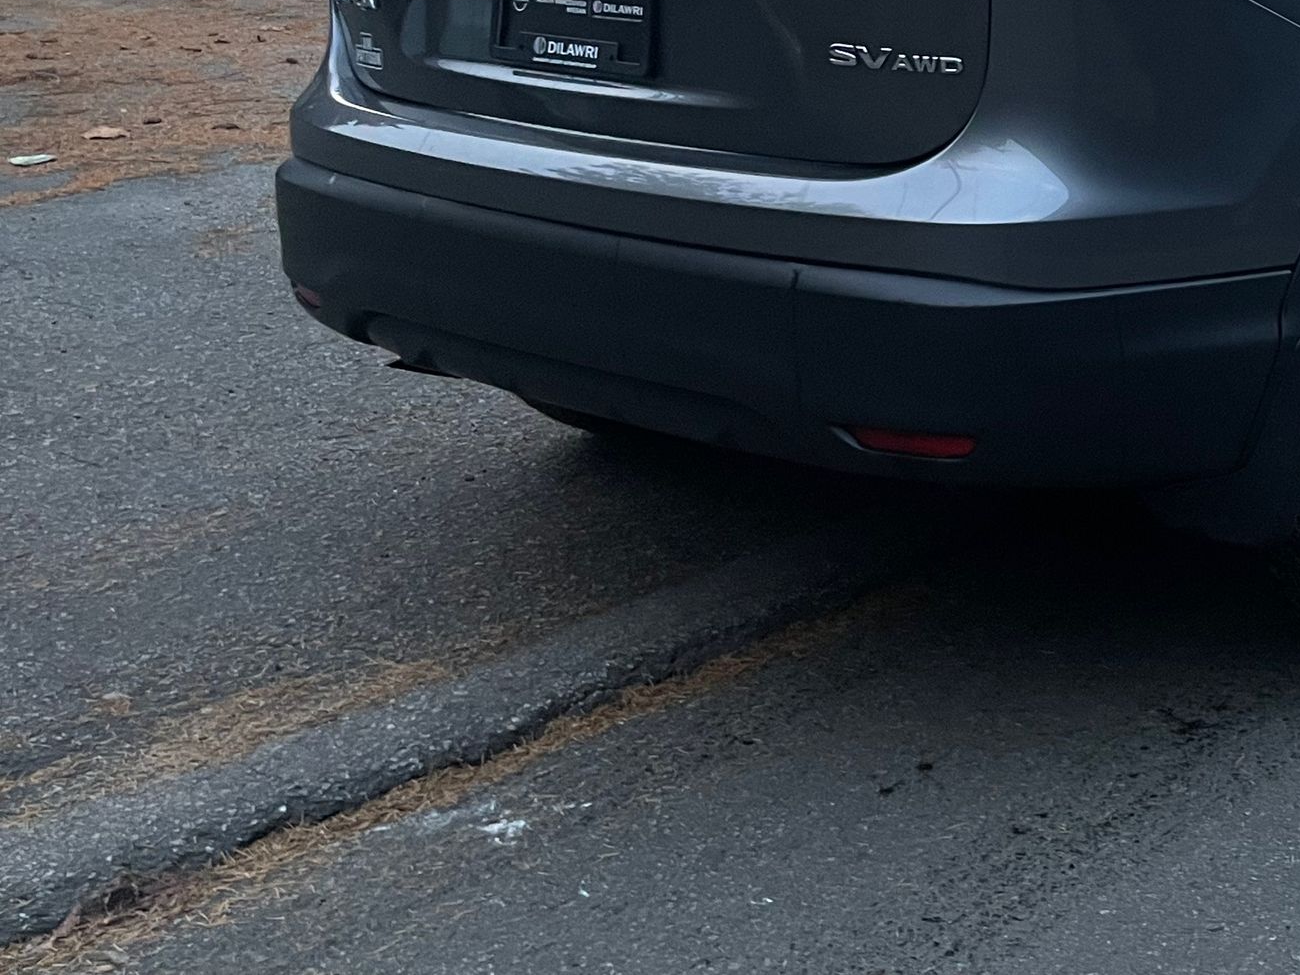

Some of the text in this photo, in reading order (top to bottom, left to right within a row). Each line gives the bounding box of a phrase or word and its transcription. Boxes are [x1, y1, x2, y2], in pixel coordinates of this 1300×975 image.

[603, 2, 644, 16] DILAWRI
[547, 40, 599, 59] DILAWRI
[828, 42, 964, 74] SV AWD
